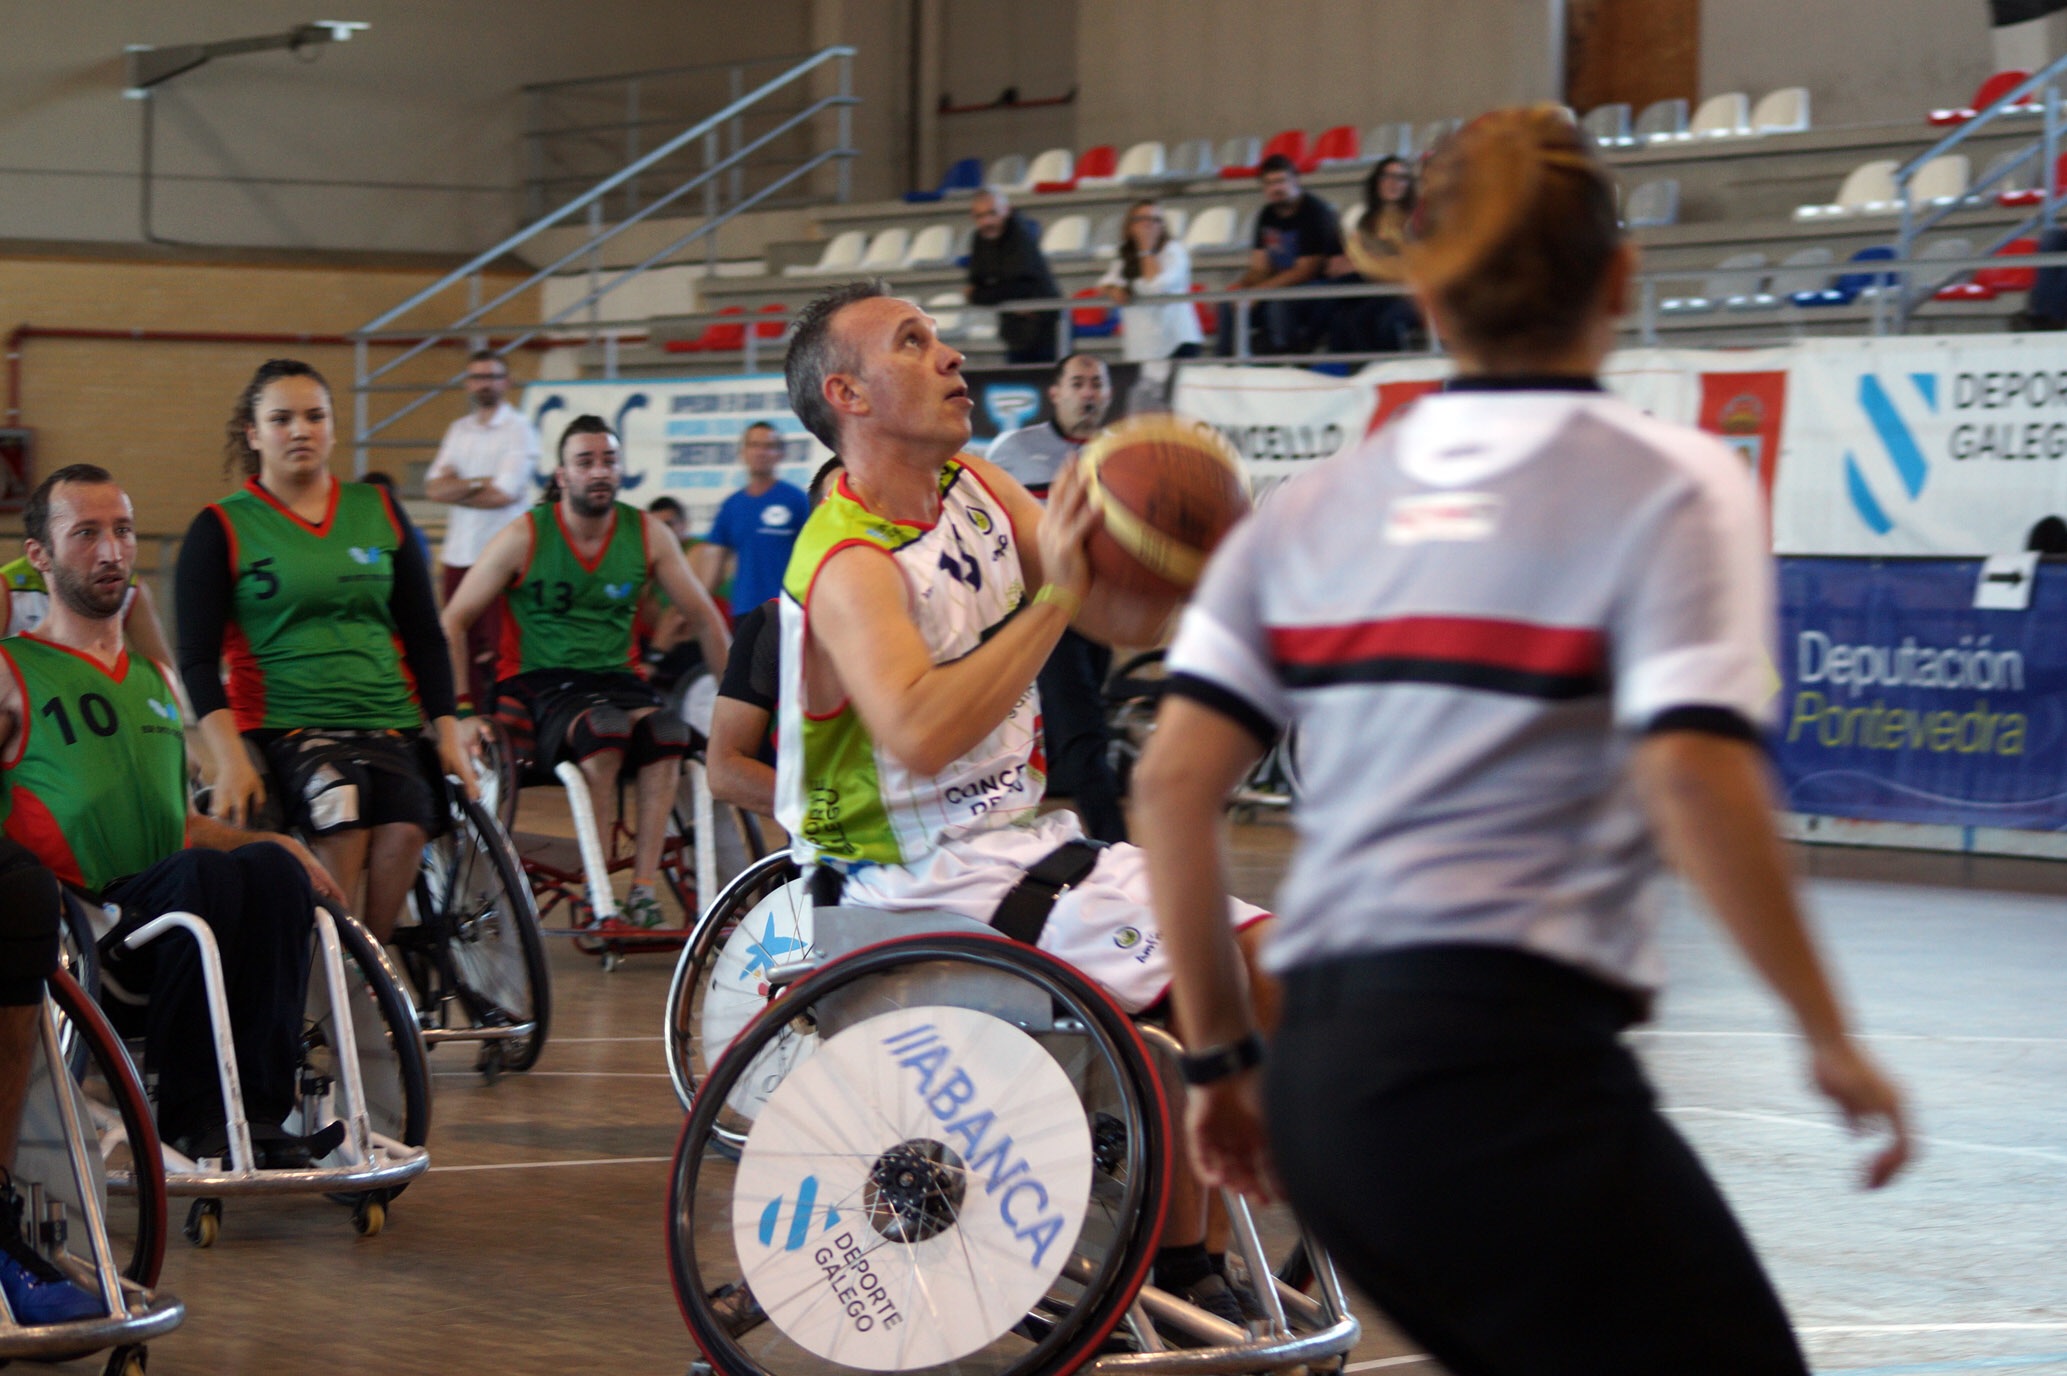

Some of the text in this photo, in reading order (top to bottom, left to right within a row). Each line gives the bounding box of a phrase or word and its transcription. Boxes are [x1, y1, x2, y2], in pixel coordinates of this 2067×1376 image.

[530, 580, 574, 616] 13
[1797, 629, 2026, 698] Deputación
[42, 692, 119, 746] 10
[1786, 690, 2028, 756] Pontevedra
[815, 1247, 874, 1332] GALEGO
[834, 1232, 904, 1331] DEPORTE
